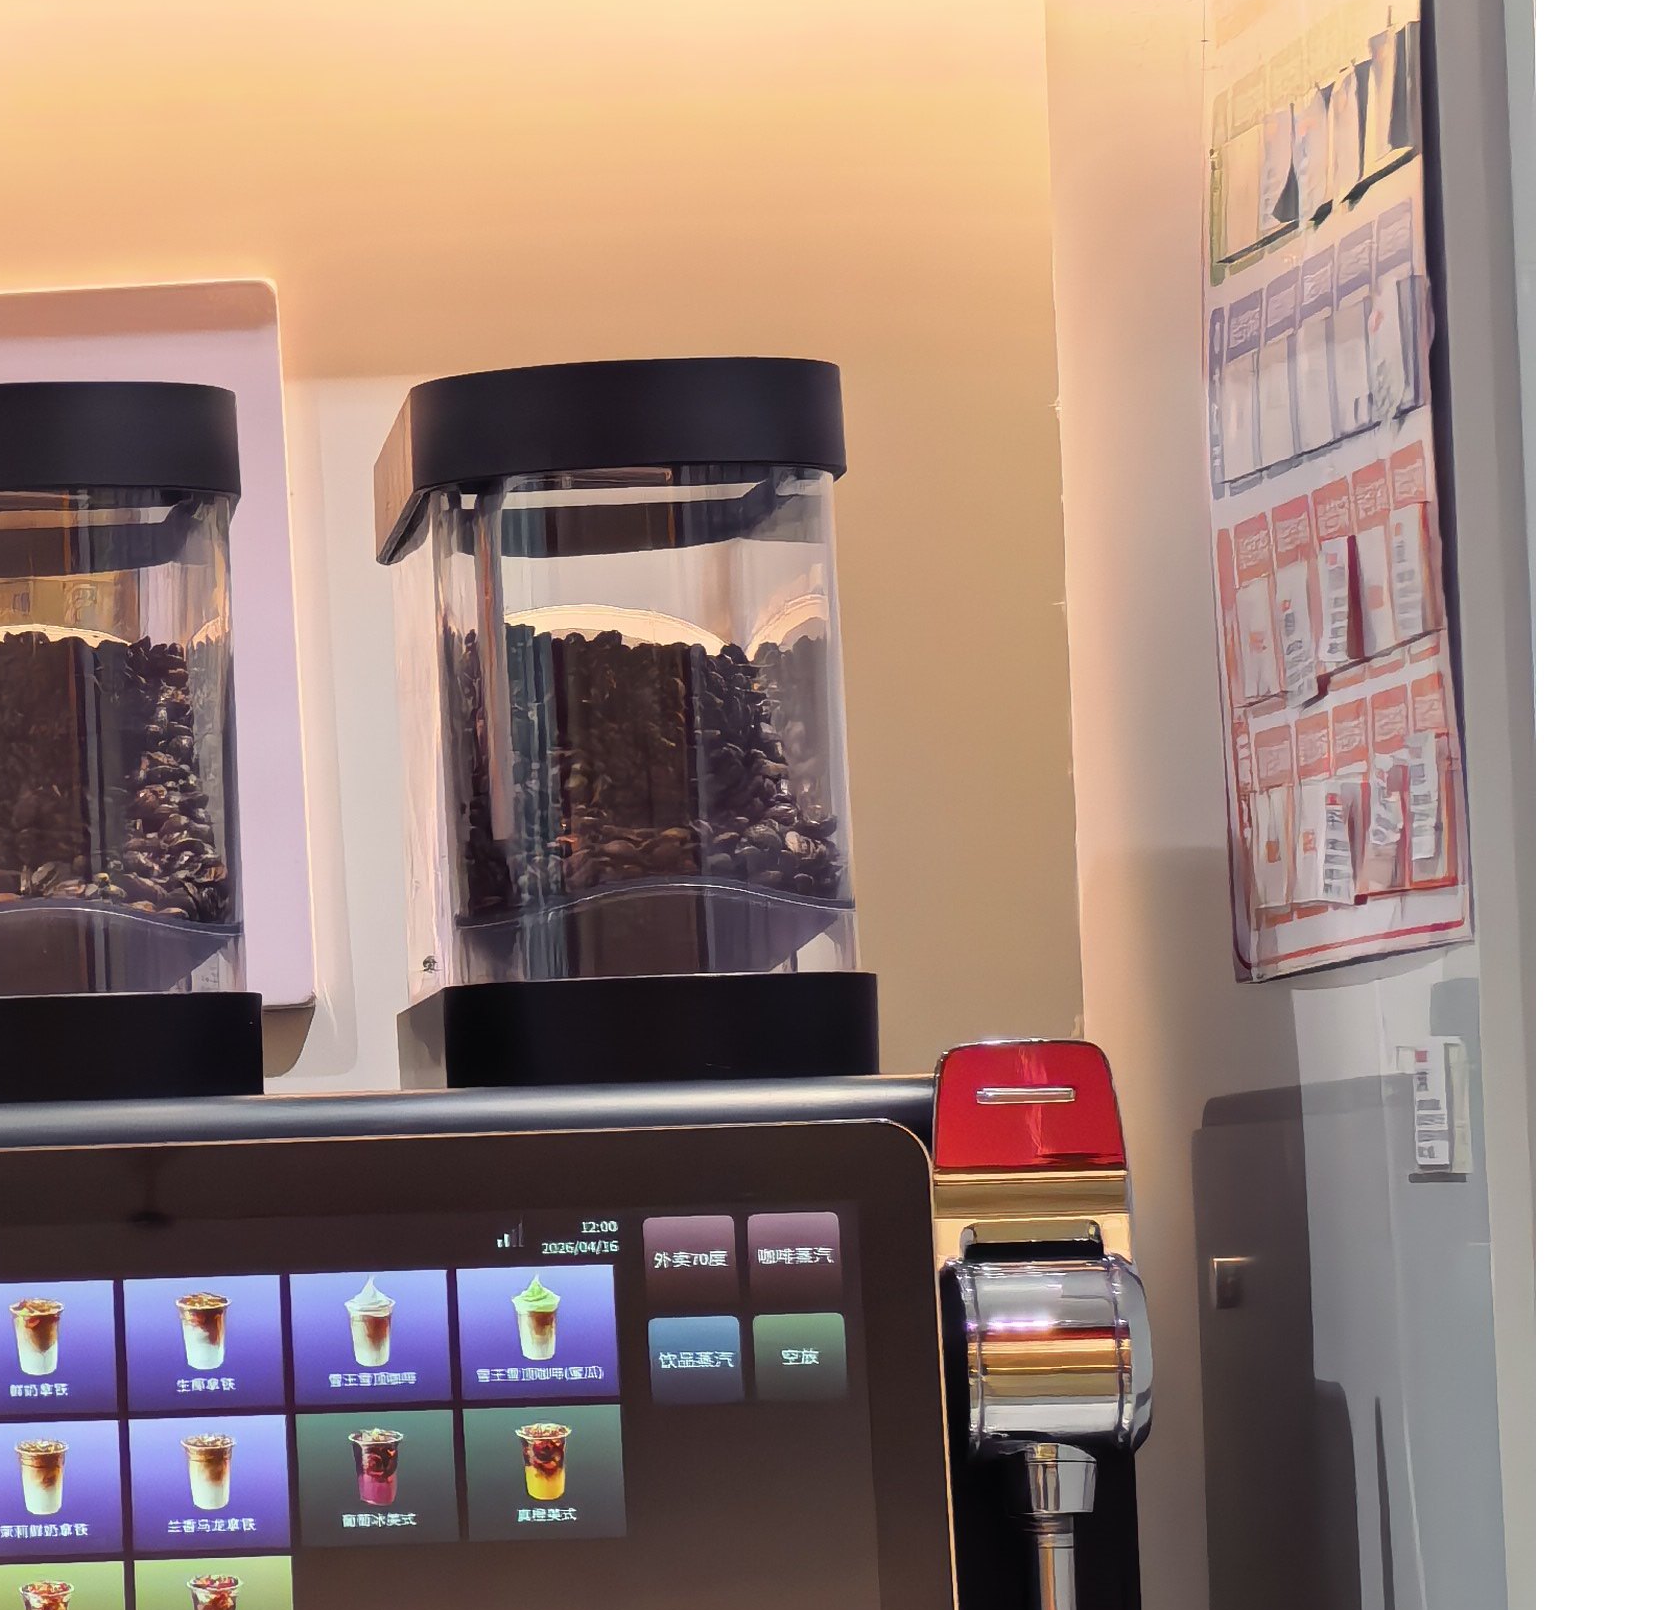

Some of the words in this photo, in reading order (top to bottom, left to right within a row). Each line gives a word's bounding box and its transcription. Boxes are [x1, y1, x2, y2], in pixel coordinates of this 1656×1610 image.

[581, 1220, 619, 1234] 12:00
[541, 1239, 619, 1256] 2026/04/16
[757, 1246, 835, 1265] 咖啡蒸汽
[653, 1250, 730, 1269] 外卖70度
[658, 1350, 735, 1369] 饮品蒸汽
[781, 1347, 820, 1366] 空放
